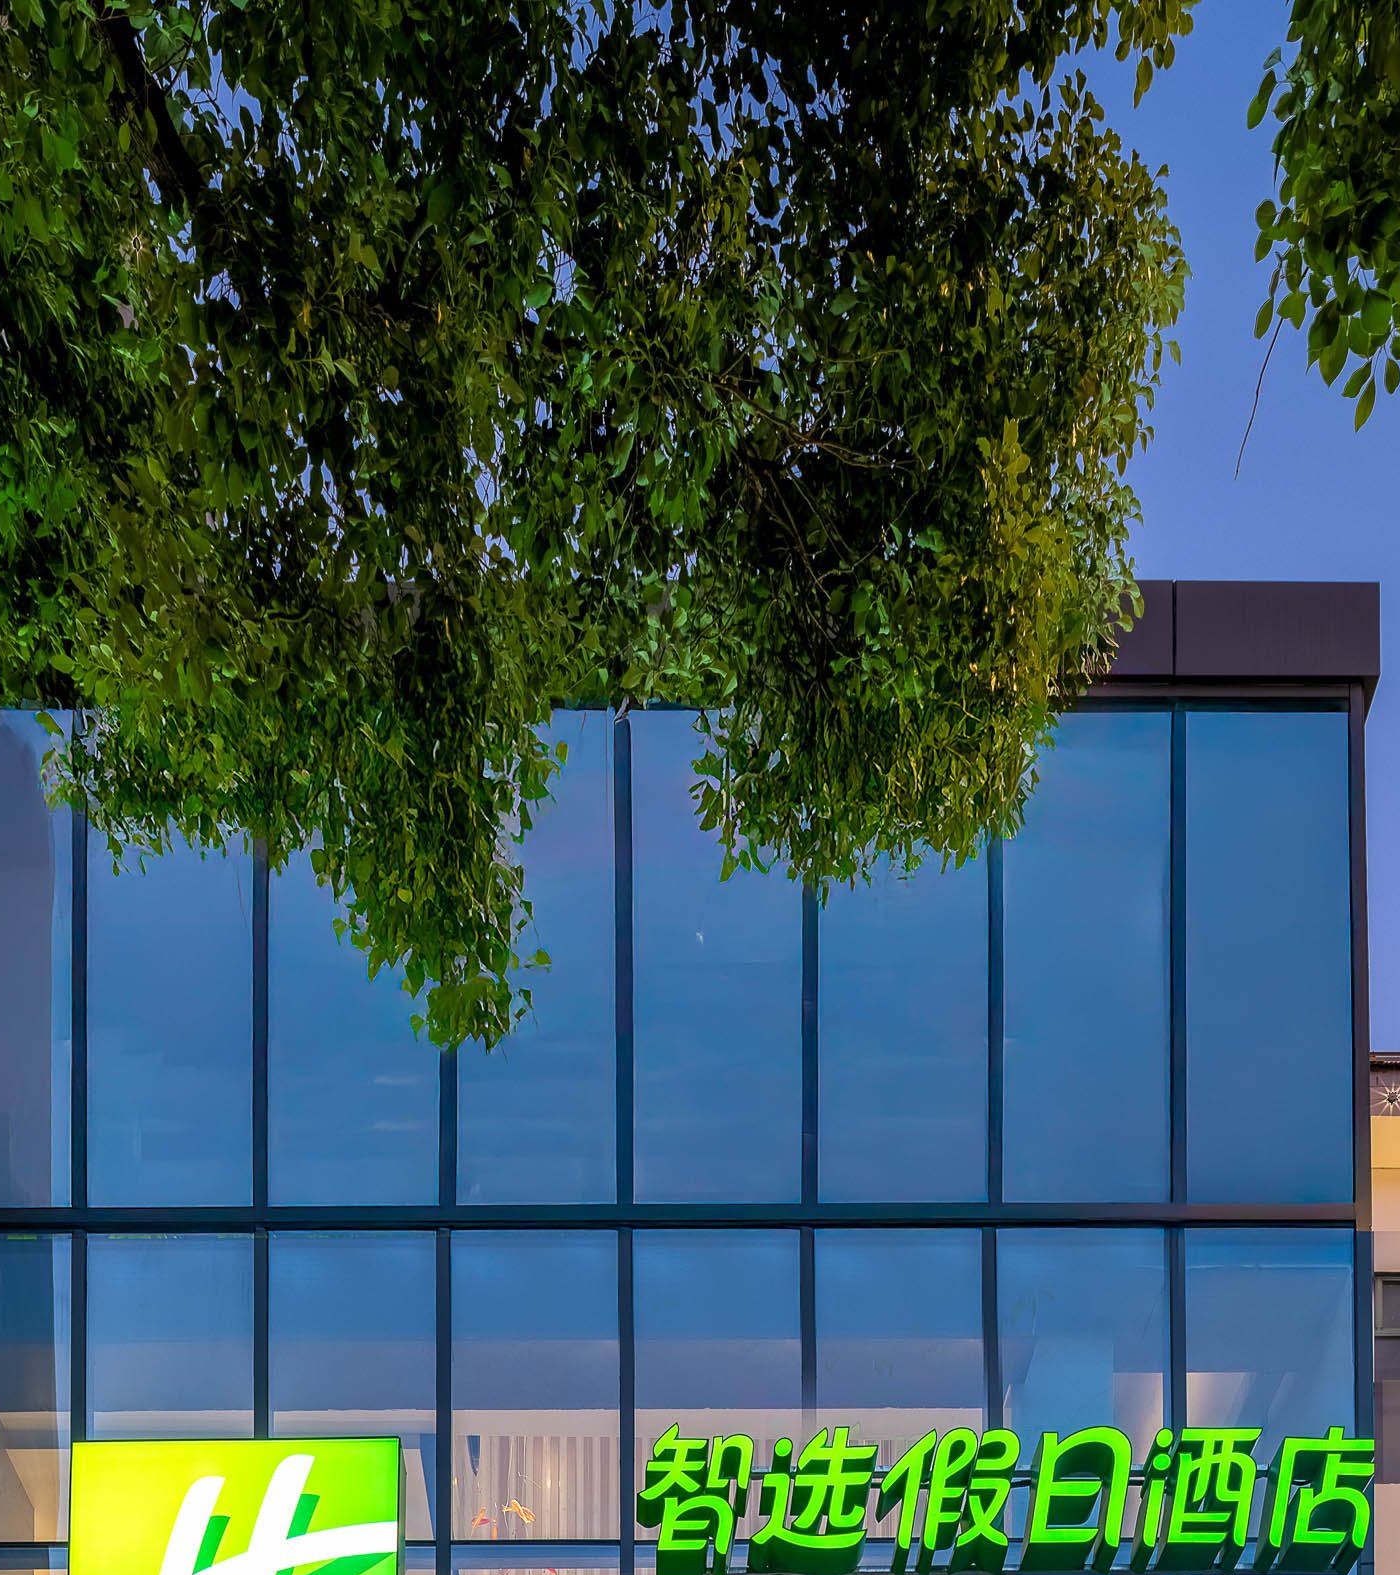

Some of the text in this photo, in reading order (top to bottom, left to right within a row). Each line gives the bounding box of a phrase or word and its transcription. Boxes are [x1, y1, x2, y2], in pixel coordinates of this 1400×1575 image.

[640, 1423, 1375, 1558] 智选假日酒店
